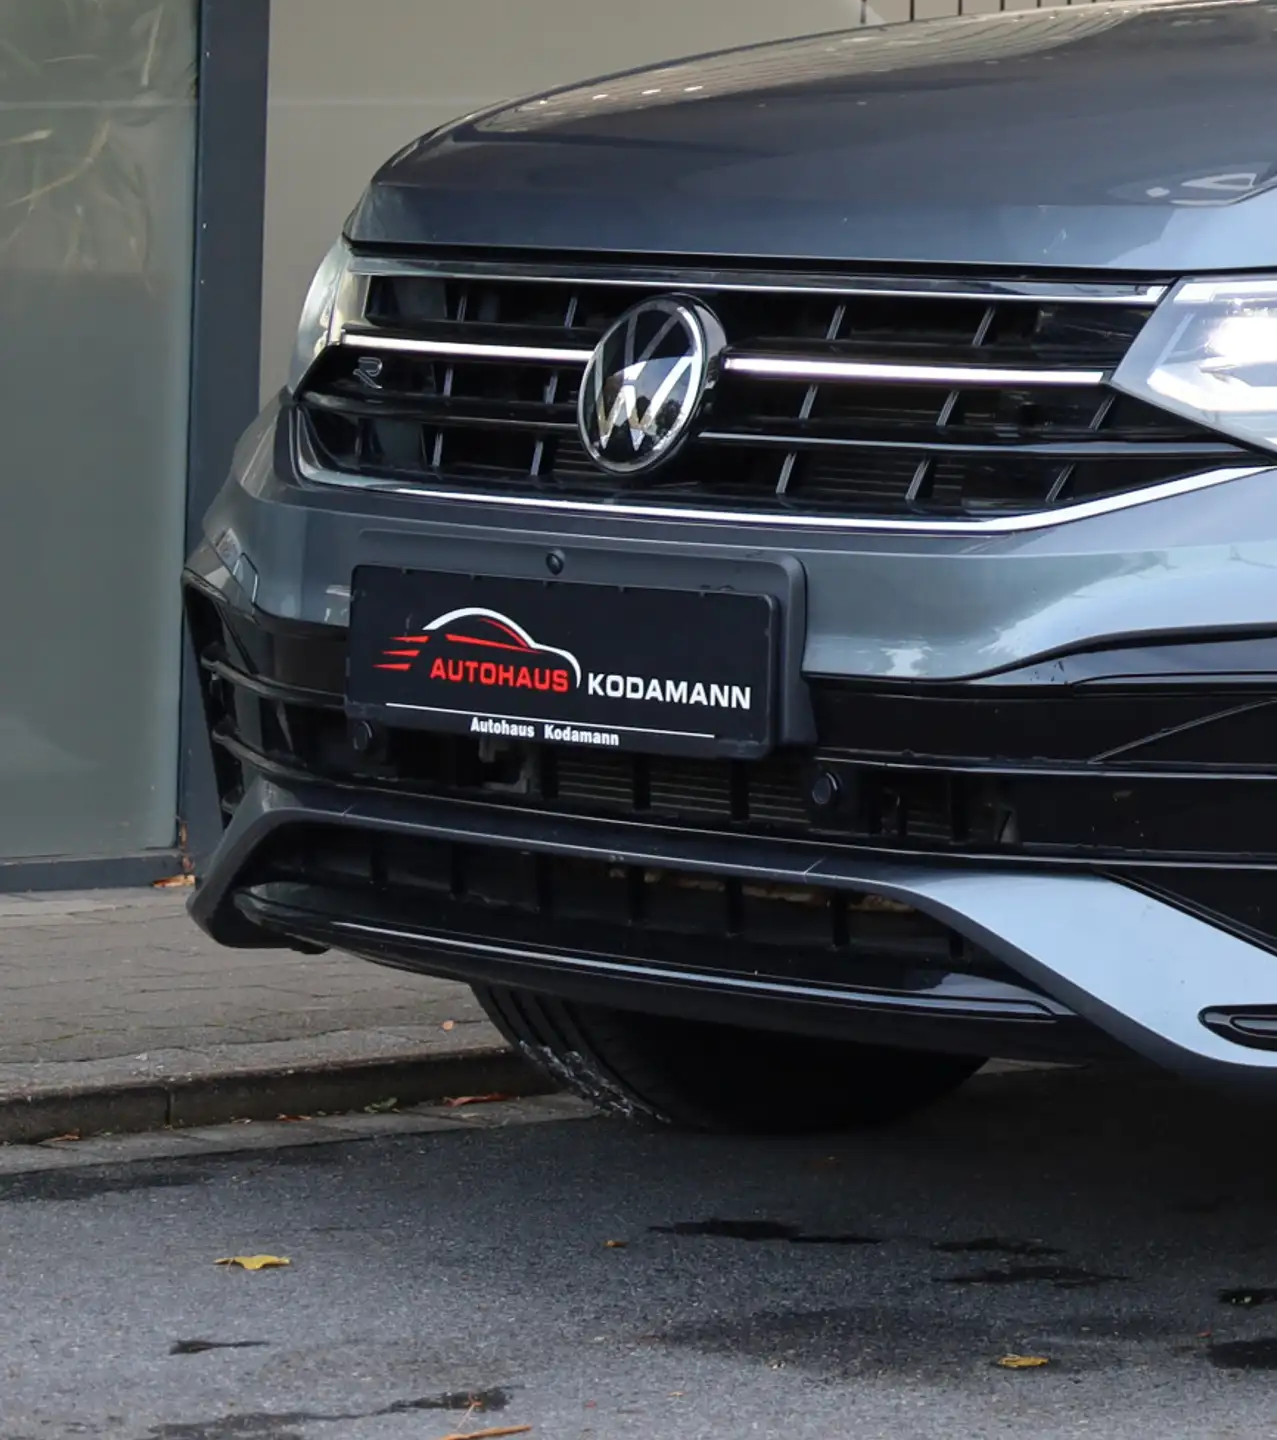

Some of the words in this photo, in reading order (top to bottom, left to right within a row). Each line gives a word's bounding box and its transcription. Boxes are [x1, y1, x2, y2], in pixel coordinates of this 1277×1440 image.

[430, 658, 569, 693] AUTOHAUS
[588, 673, 751, 710] KODAMANN
[470, 716, 535, 739] Autohaus
[544, 724, 620, 747] Kodamann
